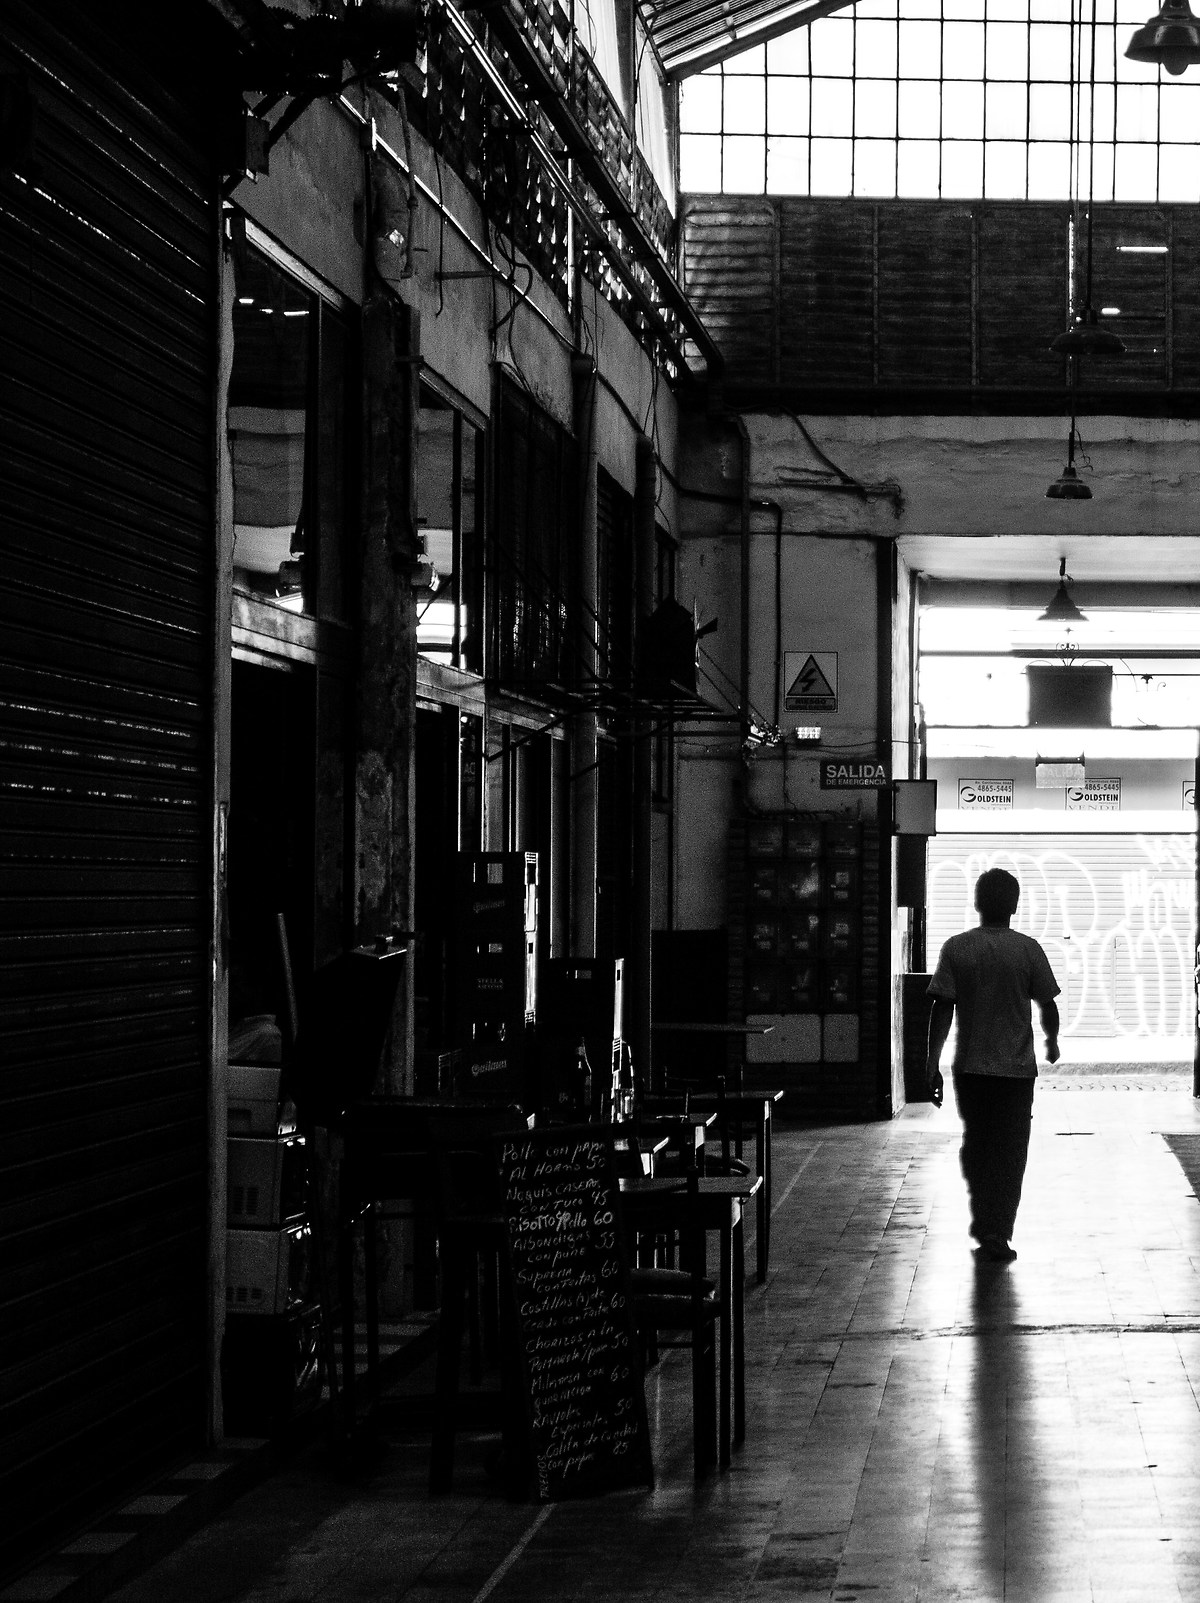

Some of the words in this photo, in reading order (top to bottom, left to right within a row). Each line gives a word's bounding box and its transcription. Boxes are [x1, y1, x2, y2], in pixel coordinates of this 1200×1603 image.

[826, 765, 886, 778] SALIDA
[960, 786, 1011, 803] GOLDSTEIN
[586, 1154, 607, 1170] 50
[591, 1188, 611, 1206] 45
[593, 1210, 614, 1226] 60
[594, 1231, 616, 1249] 55
[601, 1259, 619, 1278] 60
[610, 1292, 626, 1309] 60
[610, 1331, 629, 1350] 50
[610, 1364, 630, 1382] 60
[614, 1397, 634, 1416] 50
